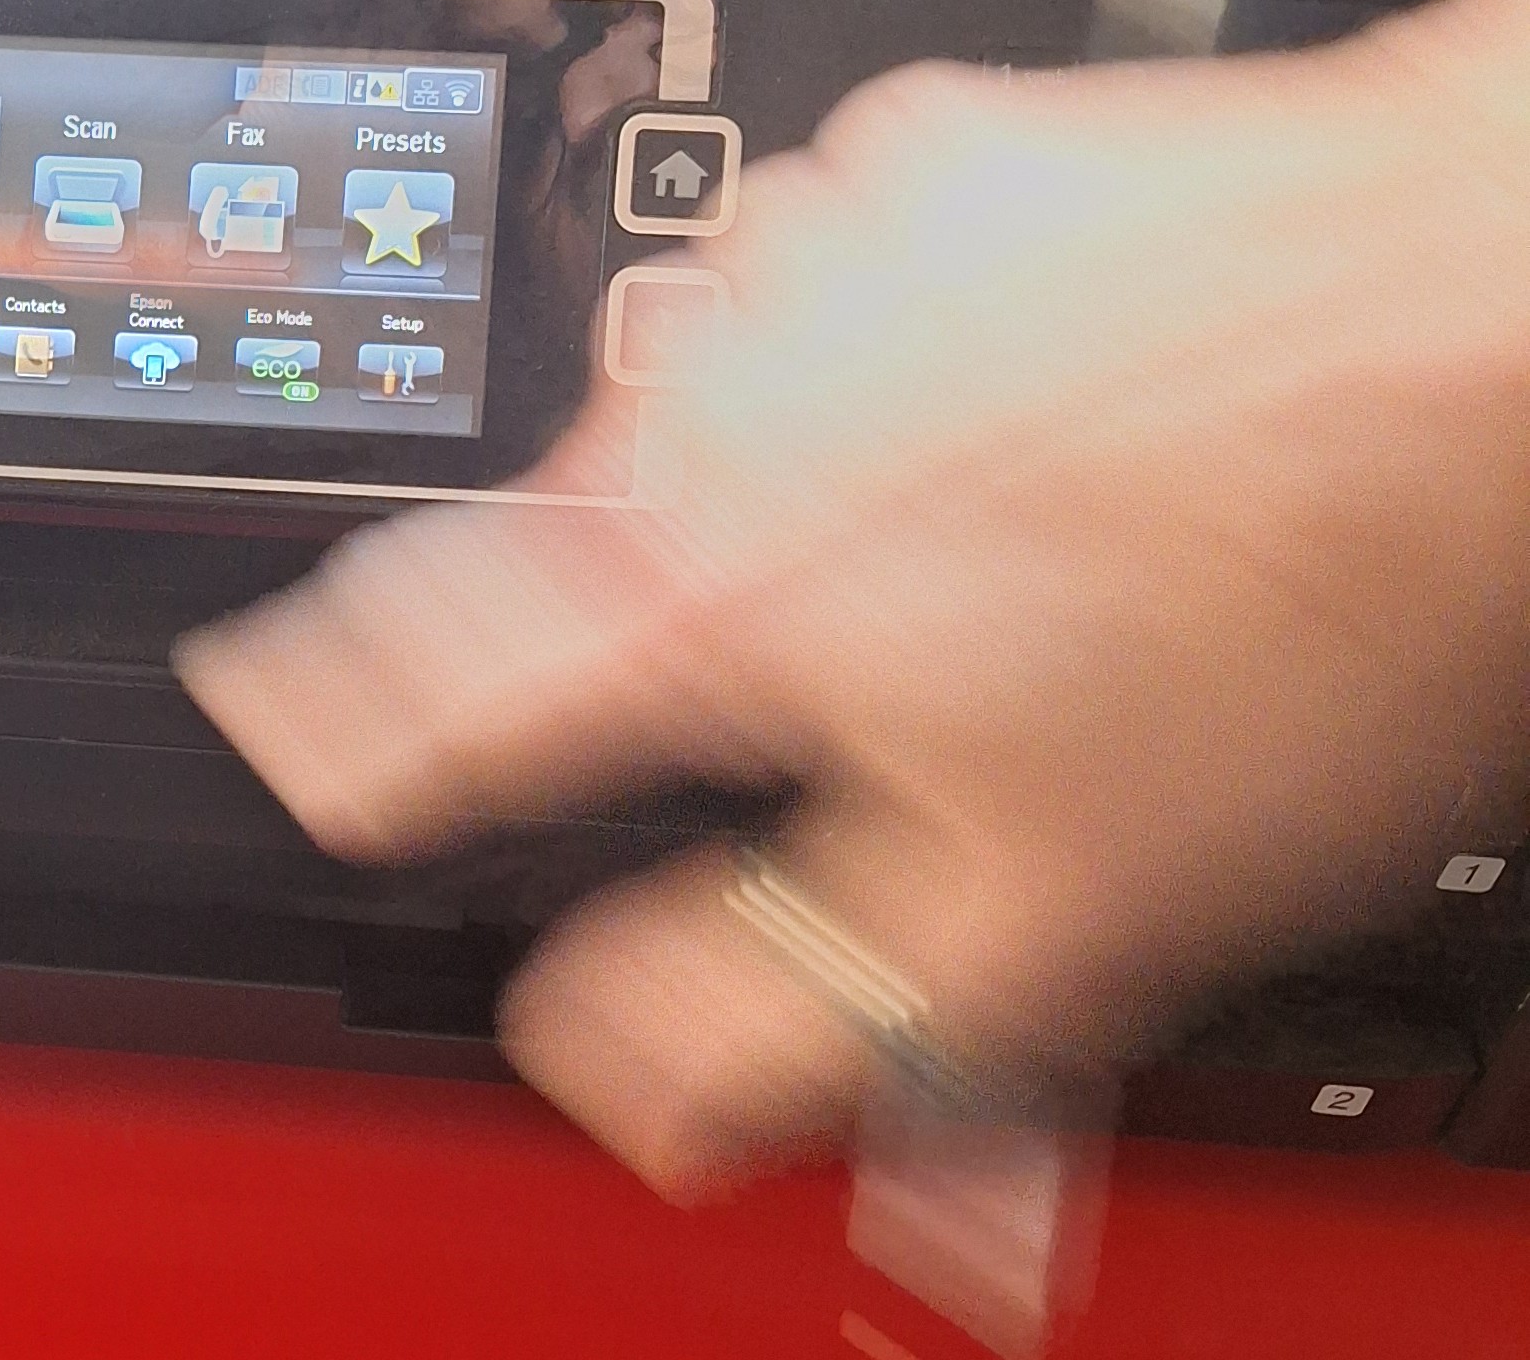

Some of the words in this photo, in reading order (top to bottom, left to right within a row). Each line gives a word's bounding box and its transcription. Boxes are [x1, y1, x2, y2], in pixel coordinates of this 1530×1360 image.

[63, 115, 117, 140] Scan
[226, 122, 266, 147] Fax
[356, 127, 446, 154] Presets
[5, 296, 67, 314] Contacts
[129, 293, 173, 311] Epson
[129, 312, 185, 330] Connect
[246, 308, 272, 325] Eco
[276, 309, 313, 326] Mode
[381, 314, 424, 334] Setup
[252, 358, 301, 380] eco
[291, 385, 310, 398] ON
[1464, 863, 1480, 885] 1
[1327, 1091, 1355, 1110] 2
